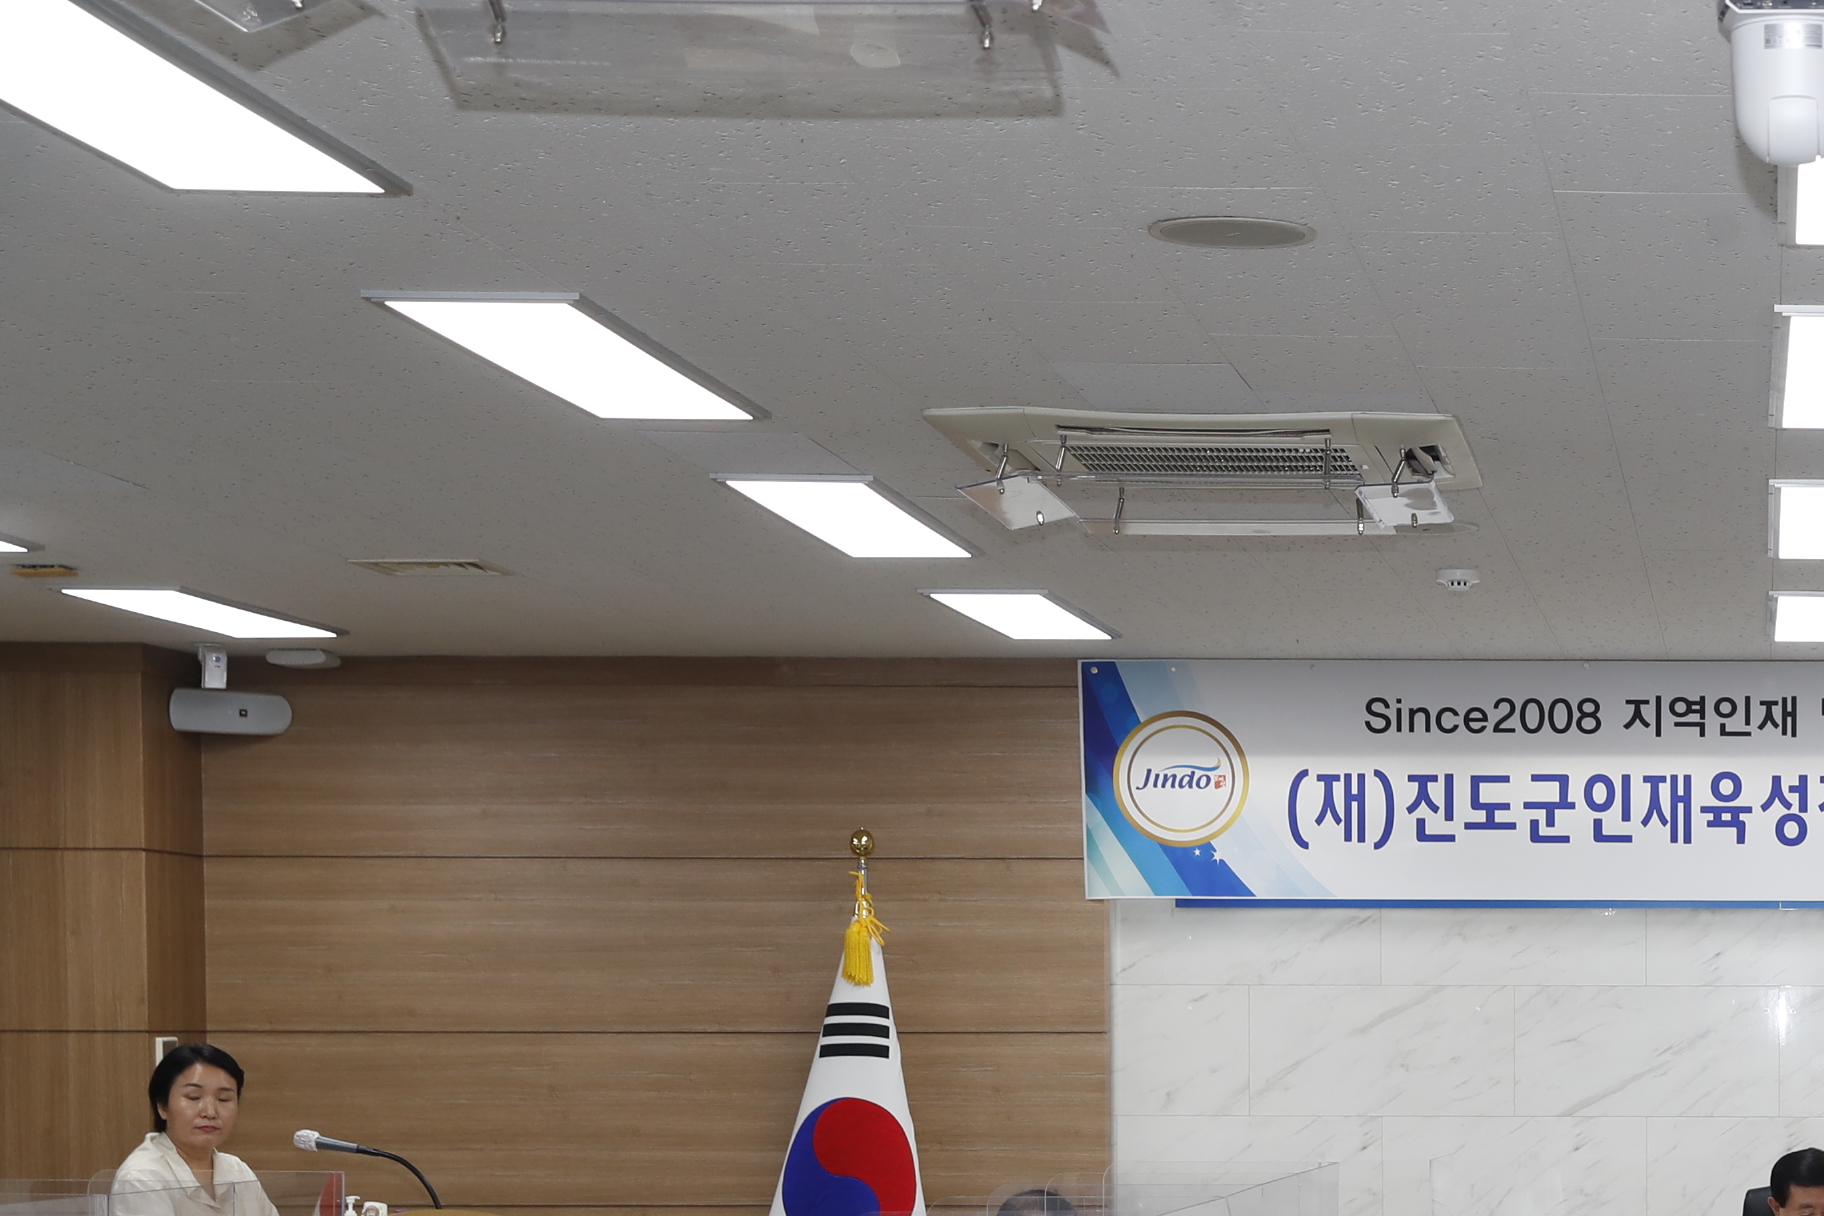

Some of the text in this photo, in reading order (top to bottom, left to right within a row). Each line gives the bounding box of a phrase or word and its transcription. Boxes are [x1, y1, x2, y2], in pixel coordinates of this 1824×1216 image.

[1364, 696, 1602, 735] Since2008
[1622, 695, 1798, 738] 지역인재
[1136, 768, 1211, 790] Jindo
